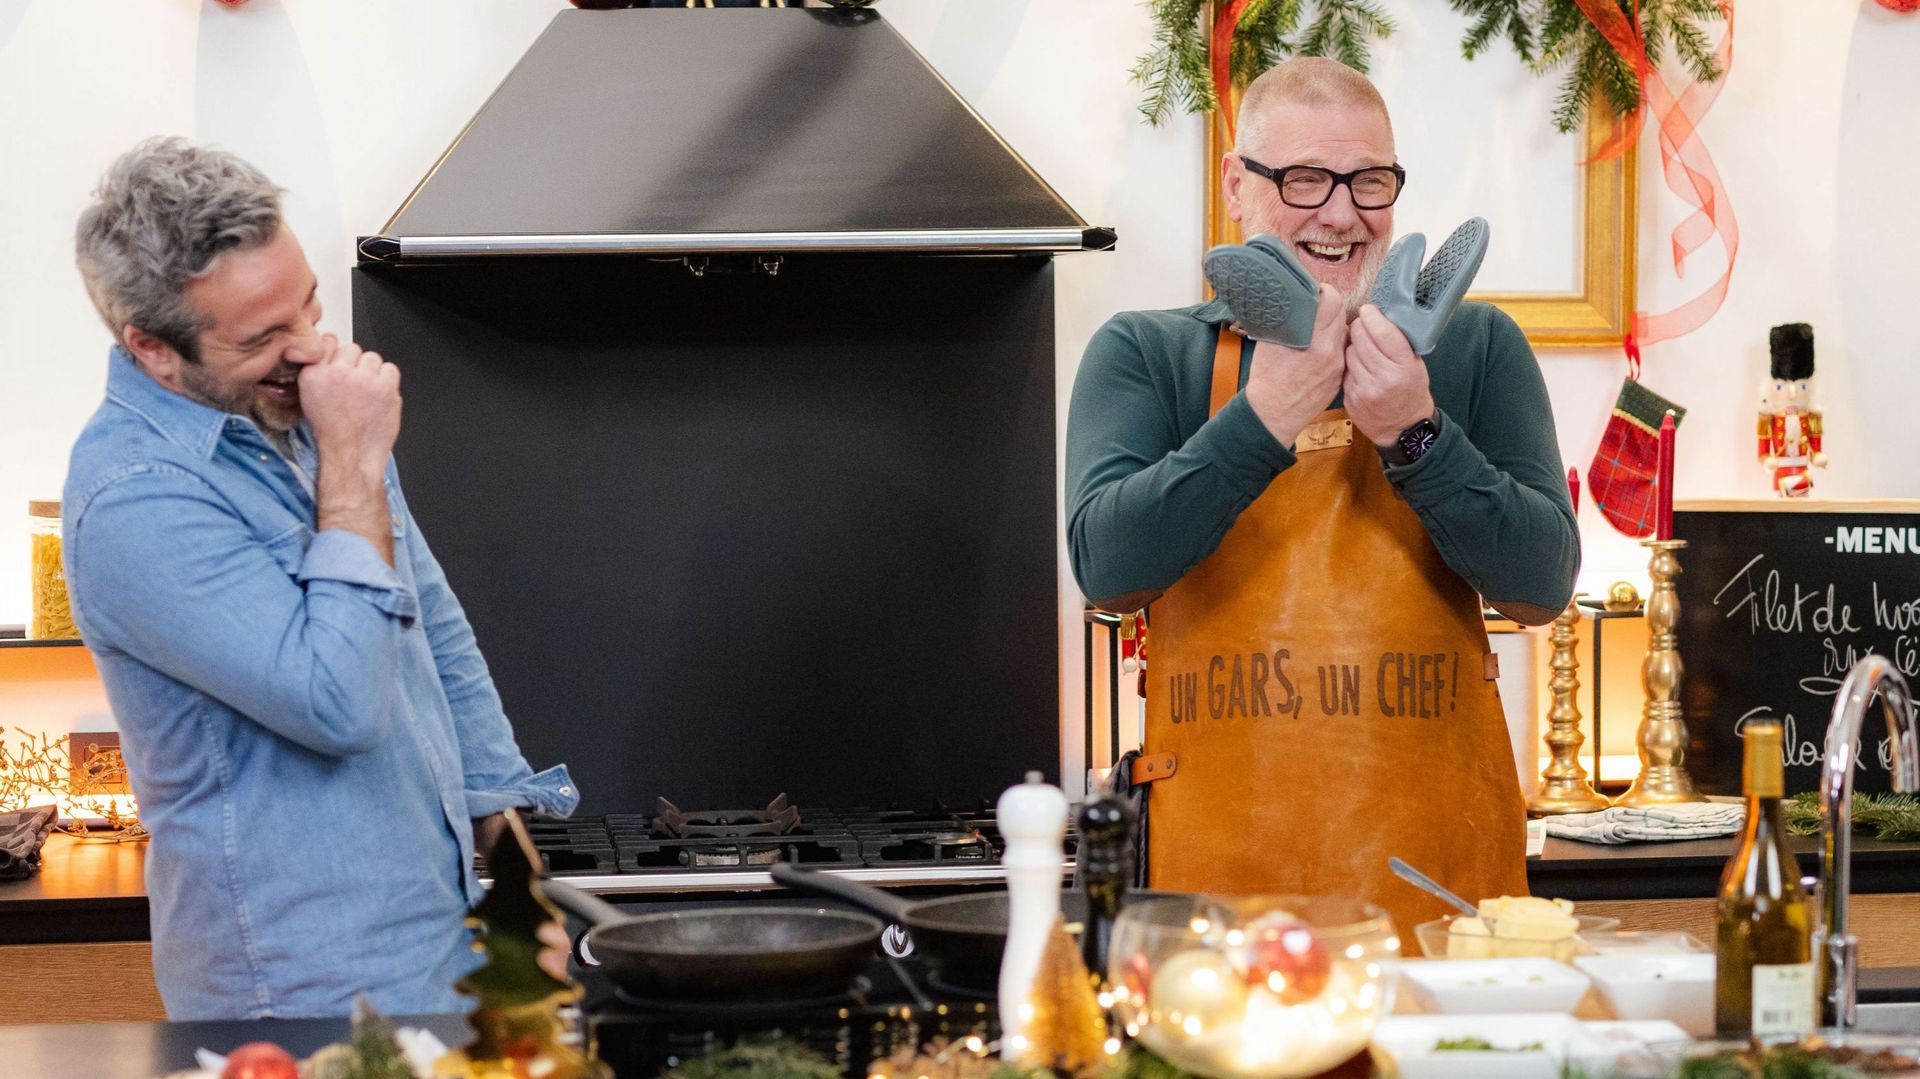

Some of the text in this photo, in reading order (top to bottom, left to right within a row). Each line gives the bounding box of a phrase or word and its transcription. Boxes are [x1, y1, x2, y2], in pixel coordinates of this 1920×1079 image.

[1713, 553, 1820, 636] Filet
[1812, 584, 1861, 634] de
[1169, 648, 1460, 724] UN GARS, UN CHEF!
